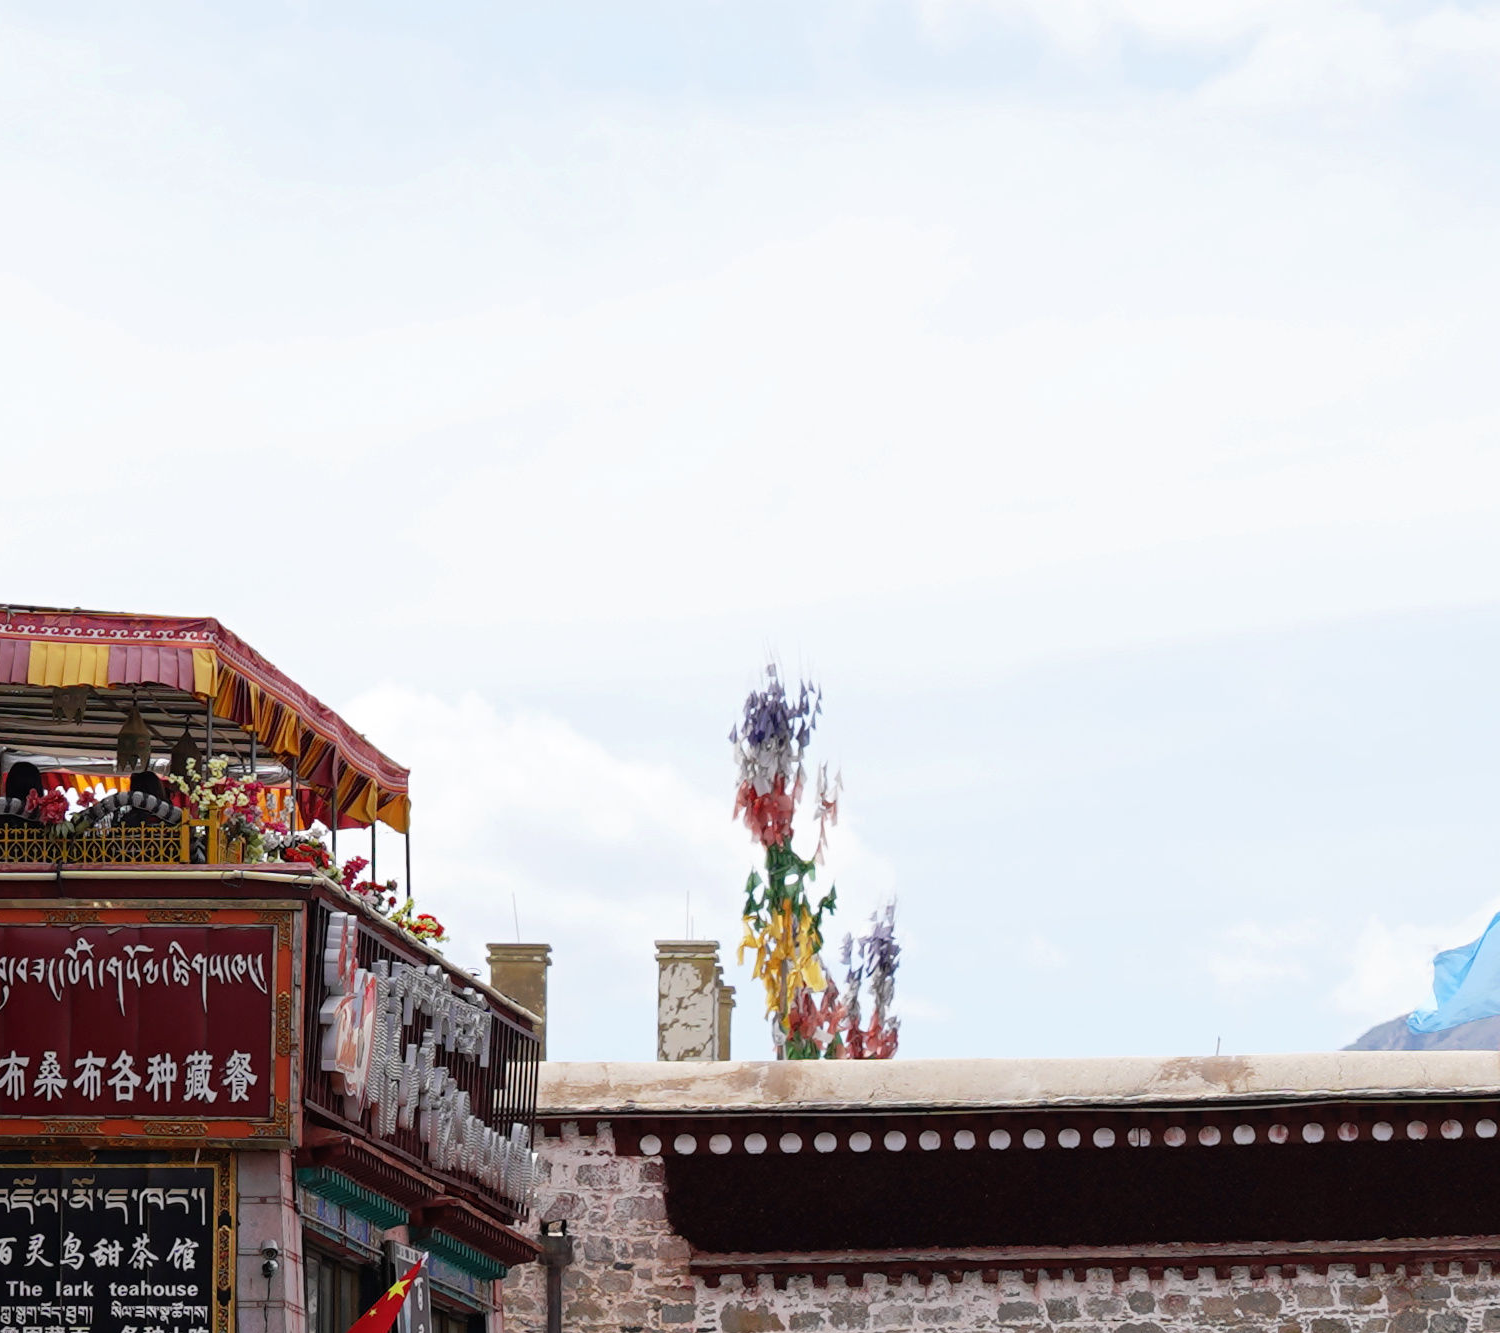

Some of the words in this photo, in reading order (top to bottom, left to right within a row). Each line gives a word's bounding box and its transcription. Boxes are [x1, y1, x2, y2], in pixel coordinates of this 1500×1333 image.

[6, 1281, 43, 1297] The
[56, 1281, 94, 1297] lark
[109, 1281, 198, 1297] teahouse
